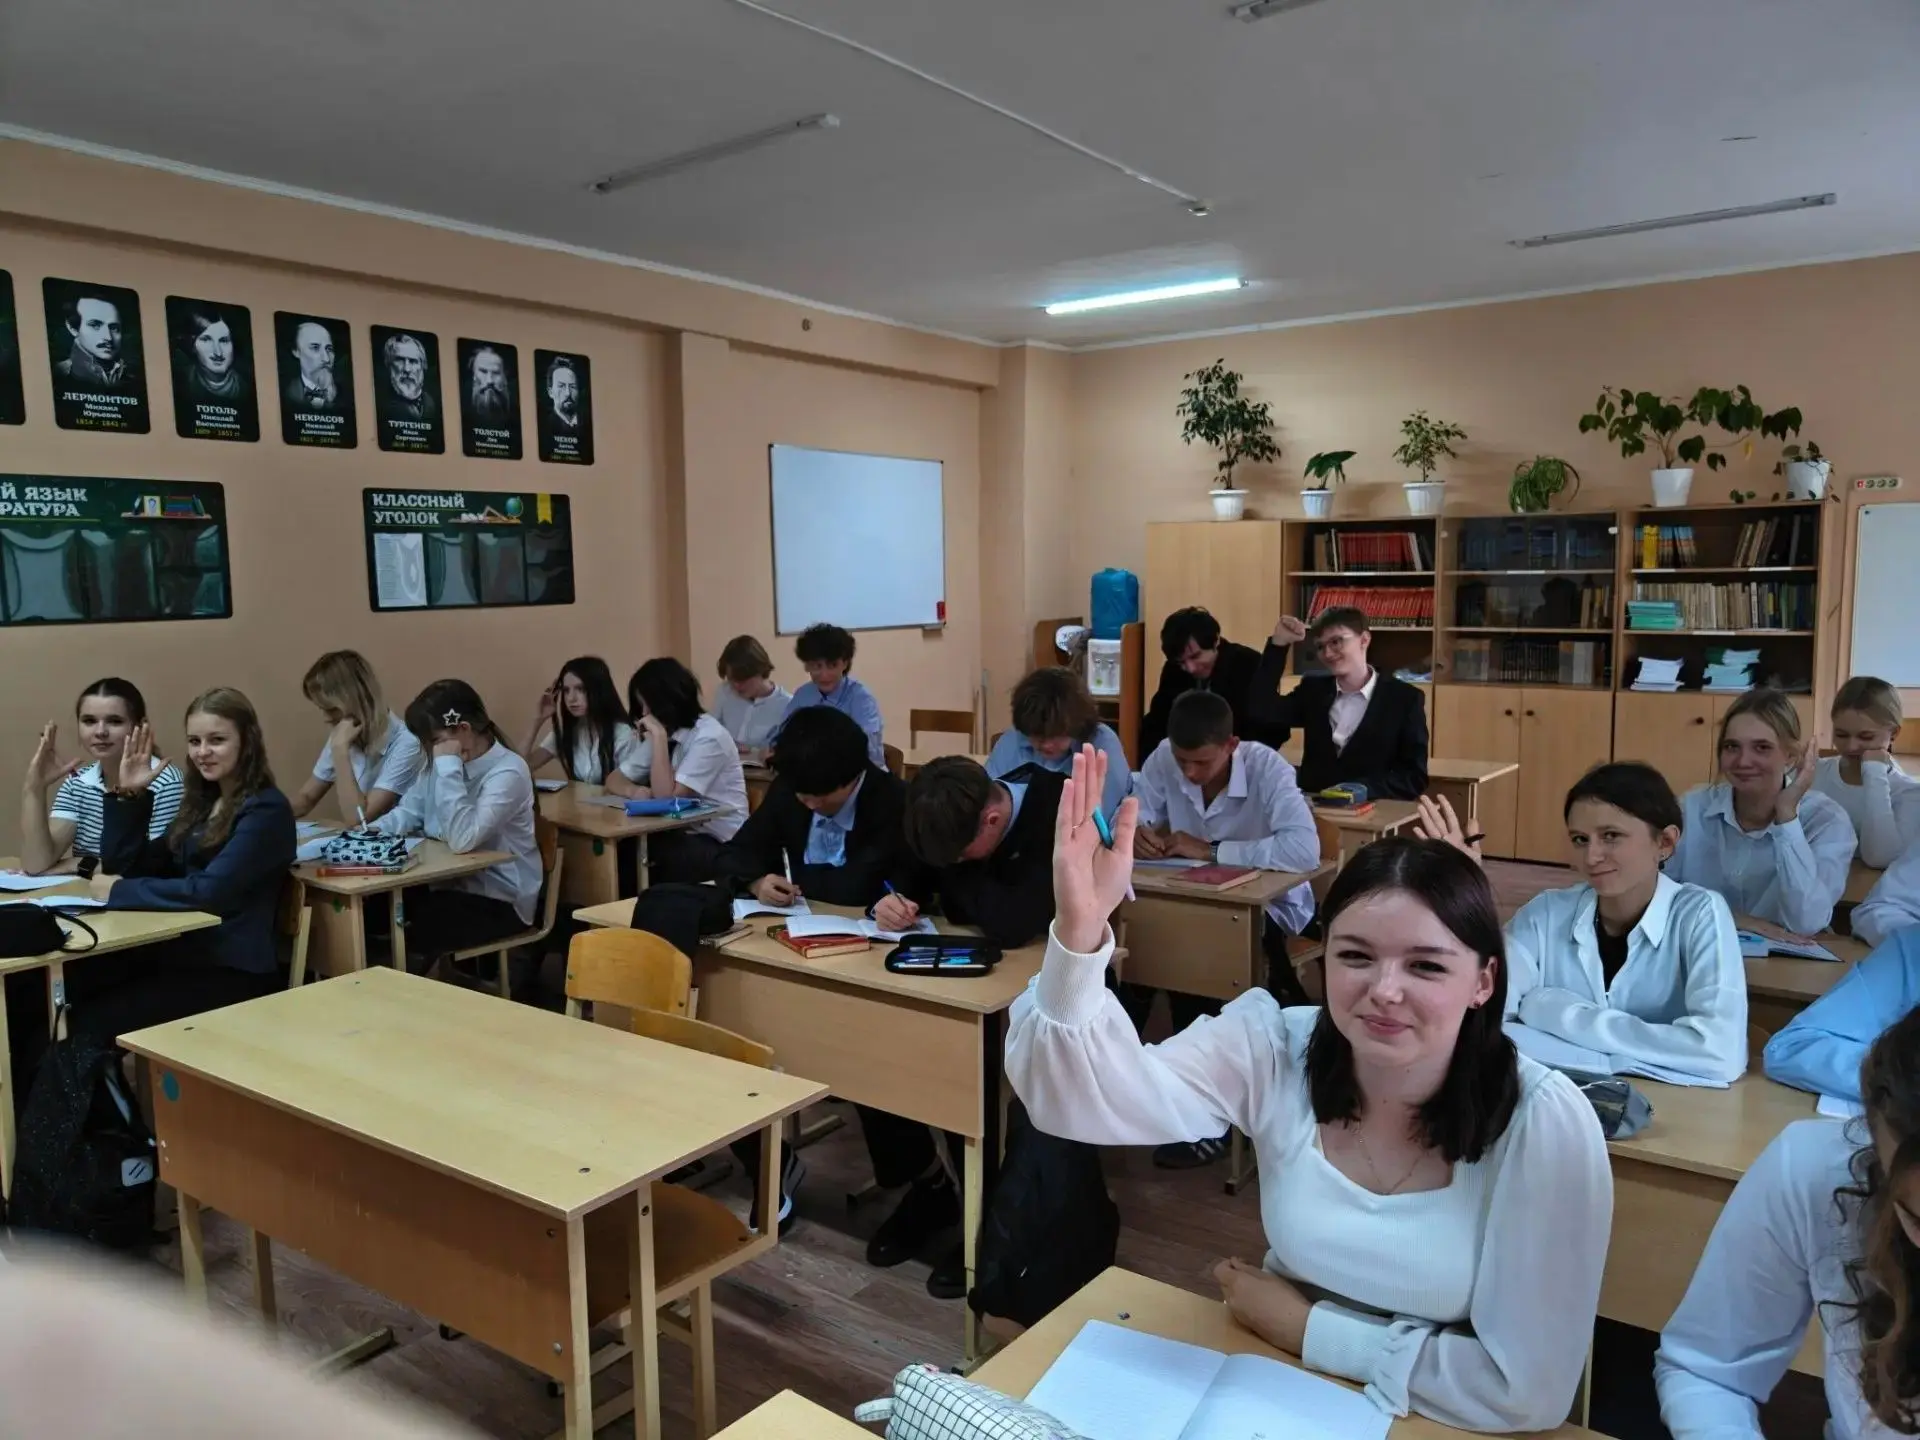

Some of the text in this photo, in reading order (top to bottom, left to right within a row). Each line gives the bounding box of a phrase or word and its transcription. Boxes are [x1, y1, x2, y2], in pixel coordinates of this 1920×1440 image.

[62, 391, 138, 405] ЛЕРМОНТОВ
[84, 402, 118, 412] Михаил
[196, 404, 237, 415] ГОГОЛЬ
[200, 414, 234, 422] Николай
[294, 412, 345, 424] НЕКРАСОВ
[388, 420, 432, 430] ТУРГЕНЕВ
[472, 427, 510, 438] ТОЛСТОЙ
[553, 435, 578, 444] ЧЕХОВ
[24, 486, 88, 502] ЯЗЫК
[372, 492, 466, 508] КЛАССНЫЙ
[373, 510, 440, 525] УГОЛОК
